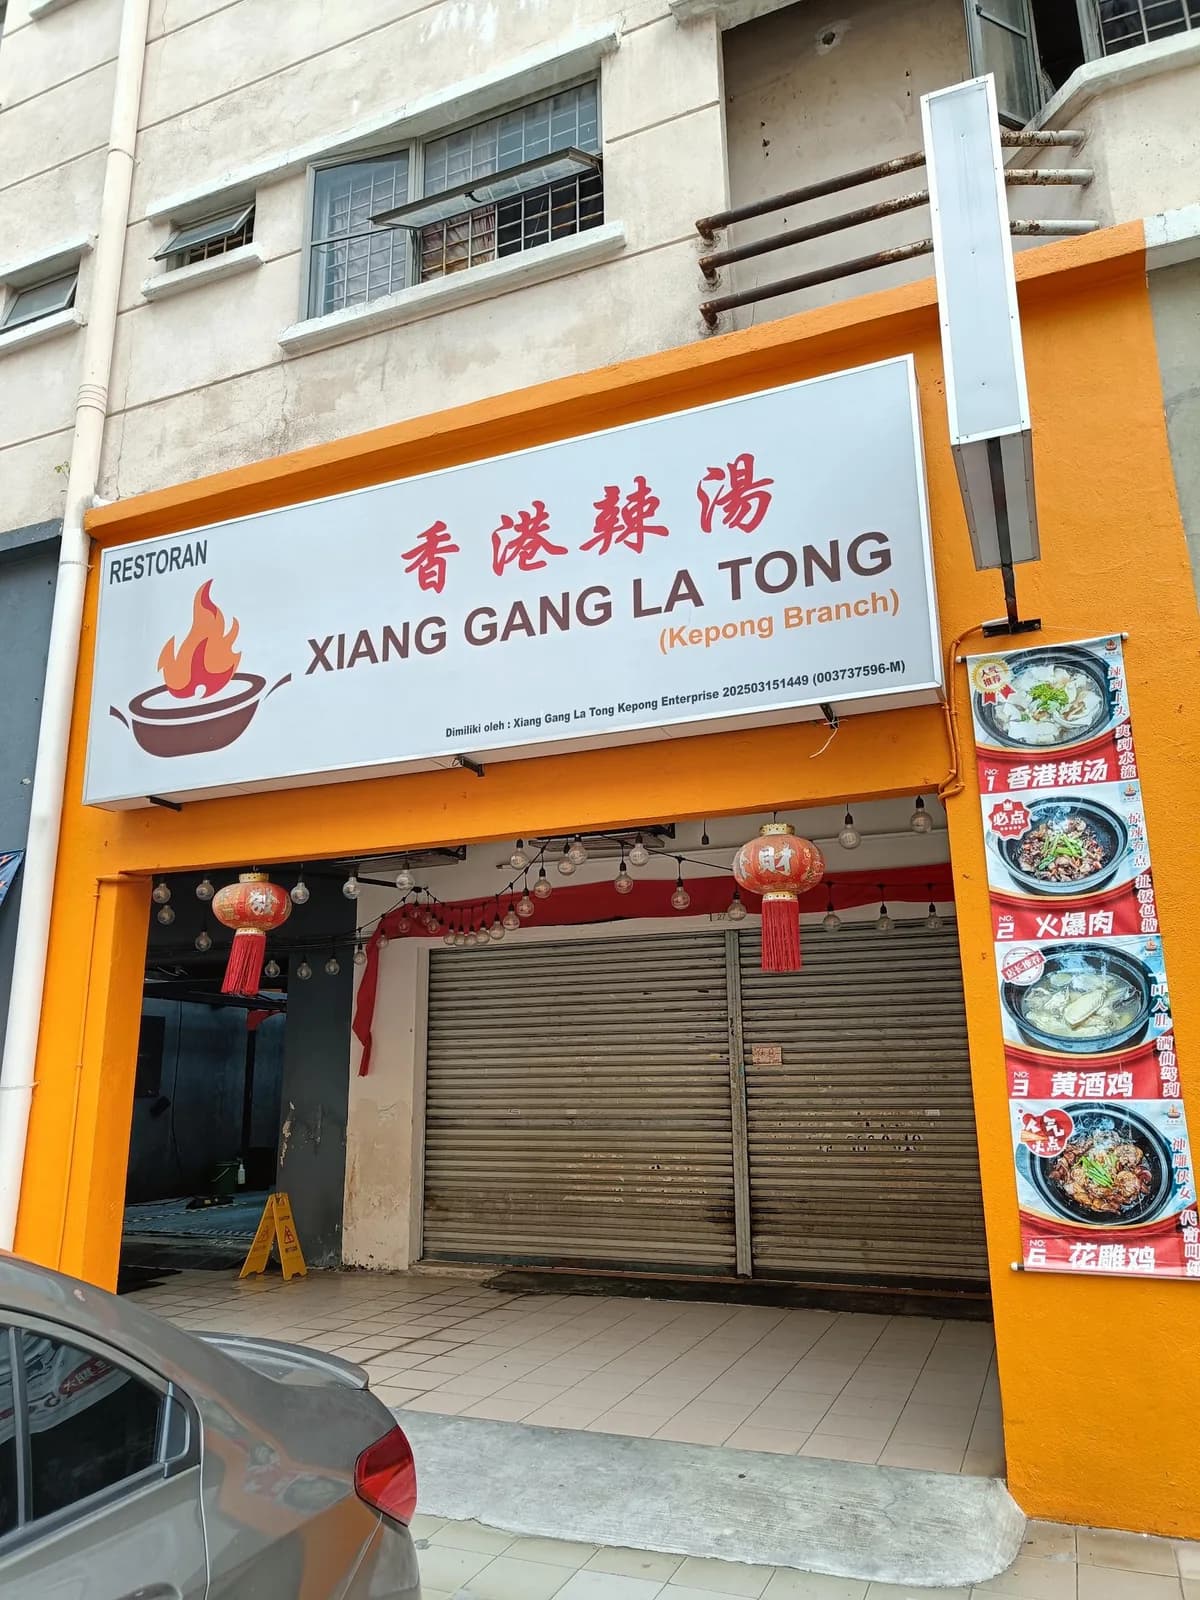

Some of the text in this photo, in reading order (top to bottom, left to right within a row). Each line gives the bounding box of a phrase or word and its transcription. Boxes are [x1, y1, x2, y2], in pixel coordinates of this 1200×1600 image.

[401, 452, 775, 594] 香港辣湯
[109, 540, 208, 585] RESTORAN
[305, 532, 892, 676] XIANG GANG LA TONG
[659, 588, 900, 655] (Kepong Branch)
[445, 723, 481, 738] Dimiliki
[483, 720, 505, 732] oleh
[513, 716, 542, 729] Xiang
[544, 712, 571, 725] Gang
[573, 709, 586, 720] La
[588, 706, 615, 718] Tong
[617, 700, 658, 715] Kepong
[661, 688, 720, 707] Enterprise
[722, 674, 809, 698] 202503151449
[812, 659, 906, 687] (003737596-M)
[986, 775, 995, 792] 1
[1007, 758, 1109, 790] 香港辣汤
[993, 810, 1025, 826] 必点
[996, 922, 1015, 939] 2
[1035, 910, 1114, 938] 火爆肉
[1012, 1079, 1029, 1096] 3
[1051, 1071, 1133, 1098] 黄酒鸡
[1069, 1242, 1155, 1272] 花雕鸡
